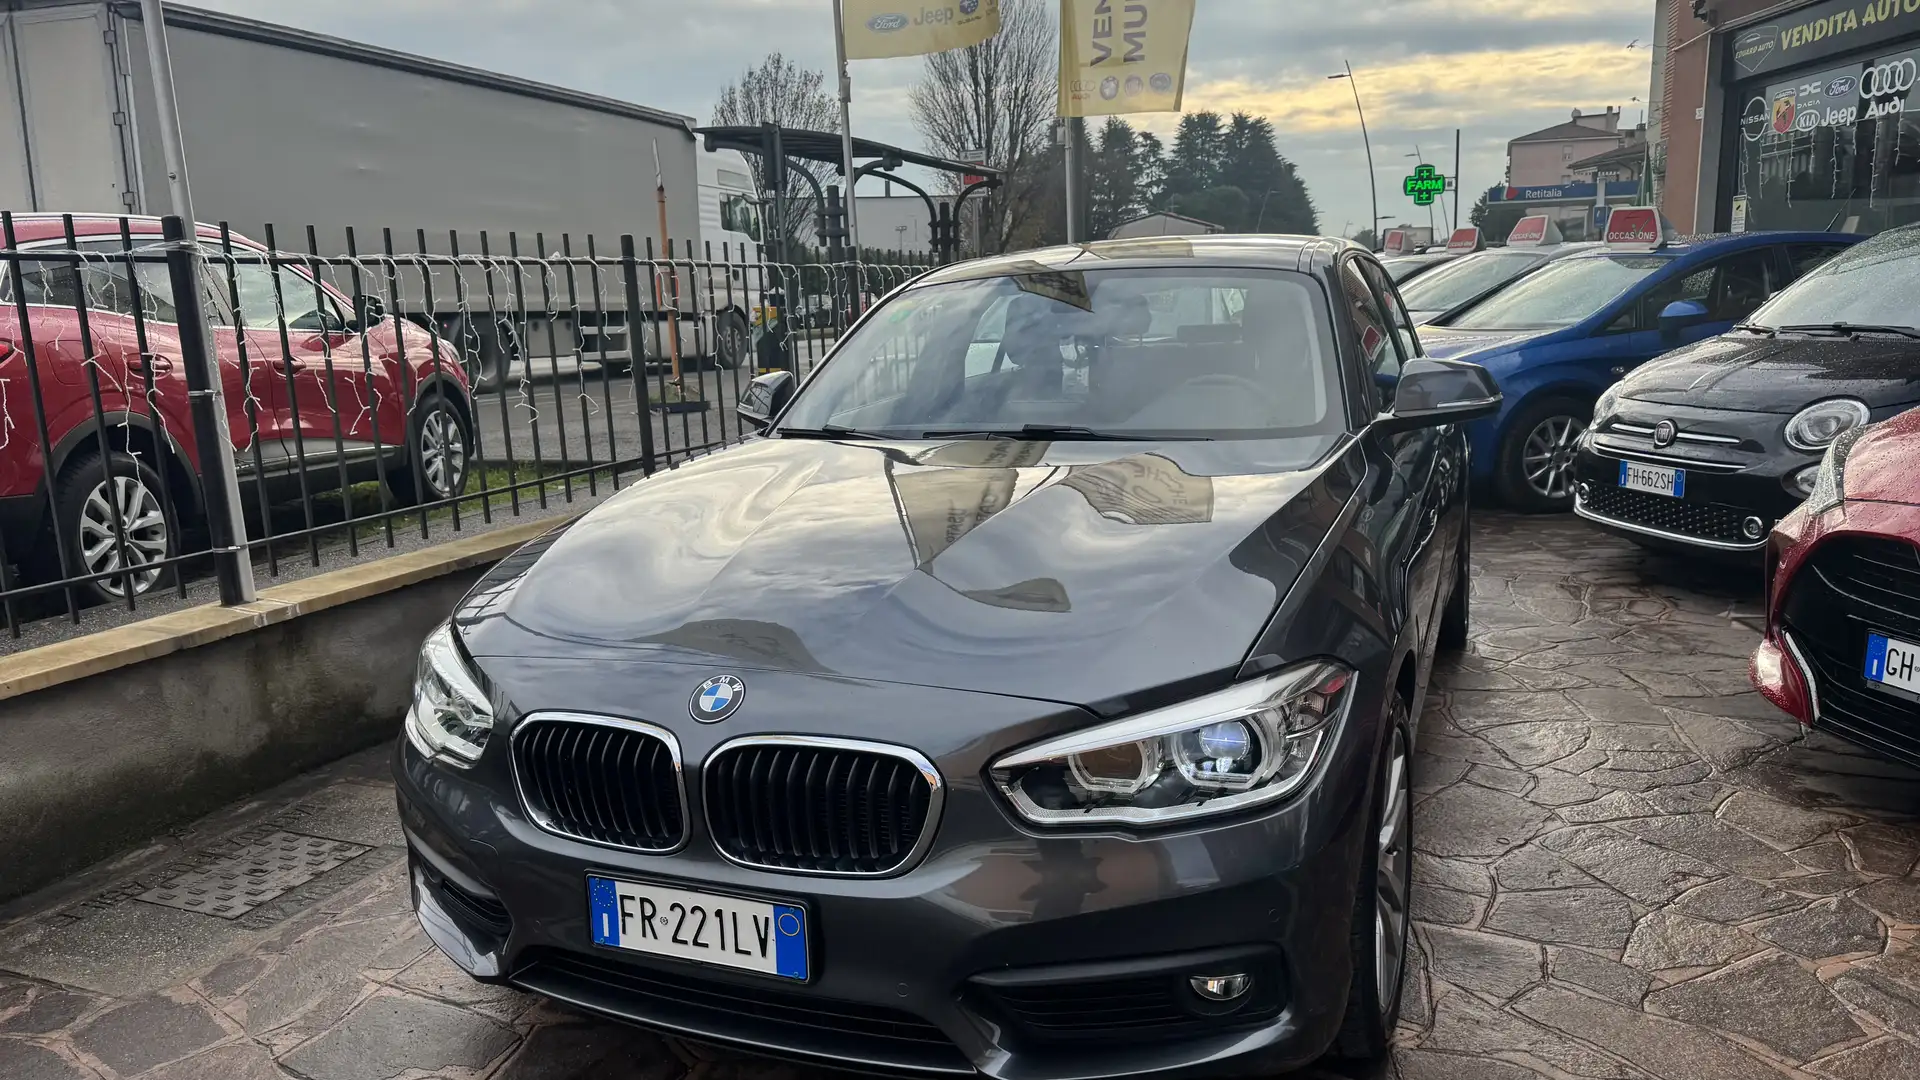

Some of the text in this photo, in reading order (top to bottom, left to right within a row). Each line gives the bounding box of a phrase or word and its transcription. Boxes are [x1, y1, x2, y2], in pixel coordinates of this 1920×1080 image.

[913, 6, 954, 26] Jeep
[1123, 0, 1148, 63] MU
[1781, 0, 1920, 50] VENDITA AUTO
[1864, 96, 1905, 119] Audi
[1740, 112, 1770, 125] NISSAN
[1799, 114, 1817, 128] KIA
[1820, 106, 1857, 127] Jeep
[1406, 180, 1443, 191] FARM
[1525, 188, 1562, 199] Retitalia
[703, 676, 742, 691] BMW
